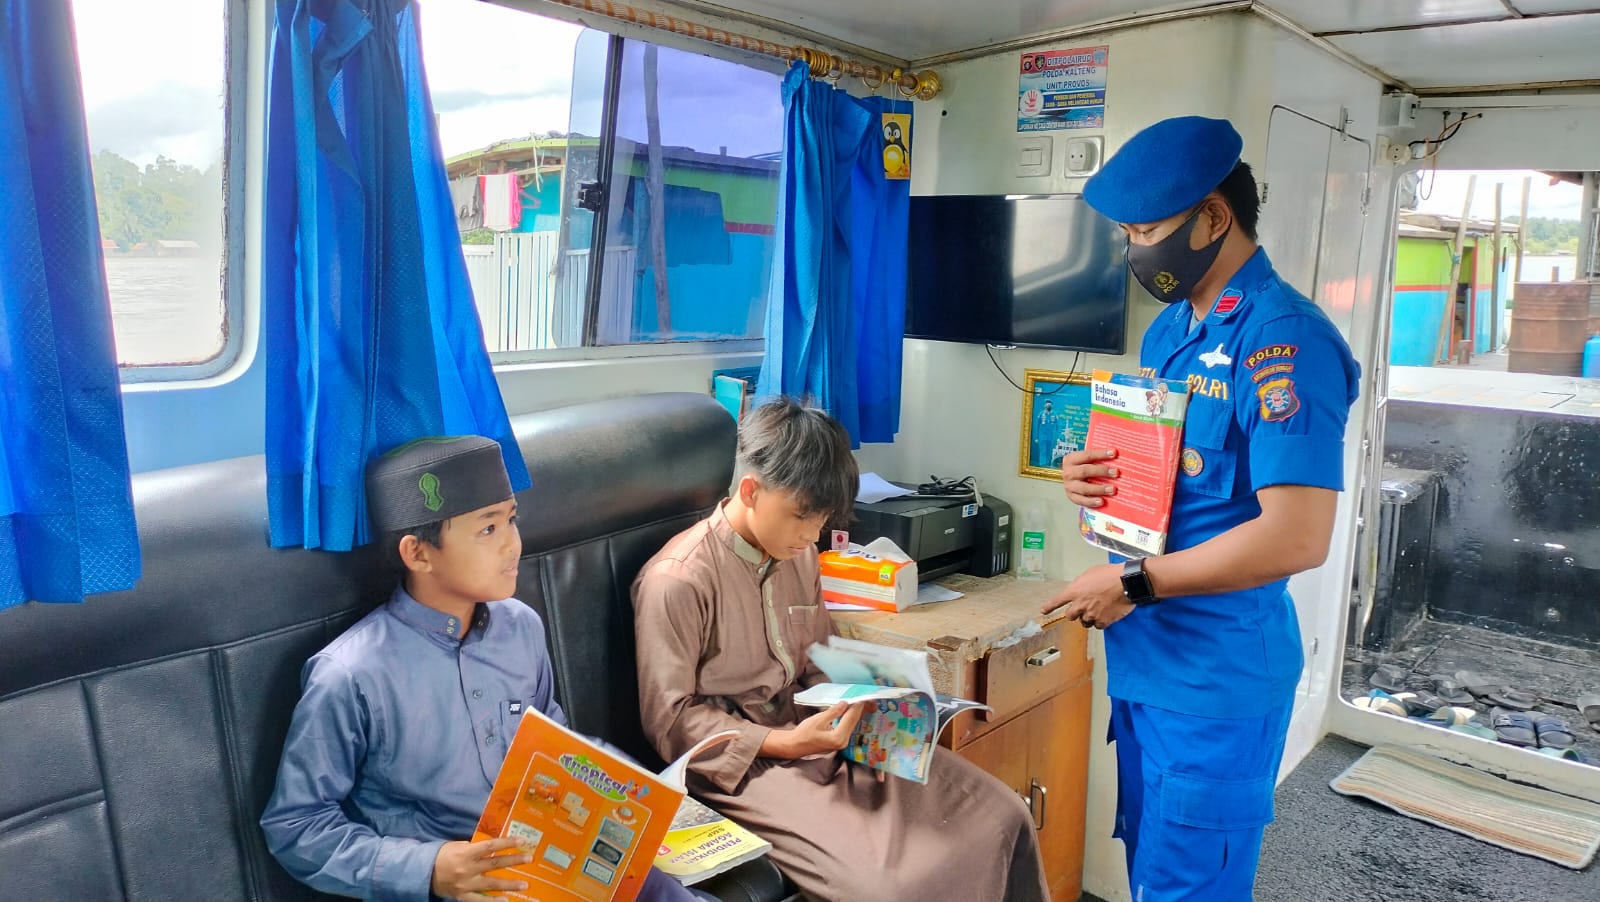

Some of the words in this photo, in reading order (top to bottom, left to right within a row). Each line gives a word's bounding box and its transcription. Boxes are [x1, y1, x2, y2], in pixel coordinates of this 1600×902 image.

[1047, 54, 1091, 66] DITPOLAIRUD
[1042, 69, 1063, 78] POLDA
[1064, 66, 1096, 76] KALTENG
[1046, 81, 1062, 90] UNIT
[1063, 79, 1090, 88] PROVOS
[1248, 346, 1291, 367] POLDA
[1095, 383, 1118, 397] Bahasa
[1186, 373, 1228, 400] POLRI
[1095, 393, 1126, 408] Indonesia
[563, 755, 627, 795] Tropical
[707, 827, 726, 838] SMP
[698, 831, 733, 851] AGAMA
[669, 848, 698, 864] ISLAM
[684, 837, 742, 865] PENDIDIKAN
